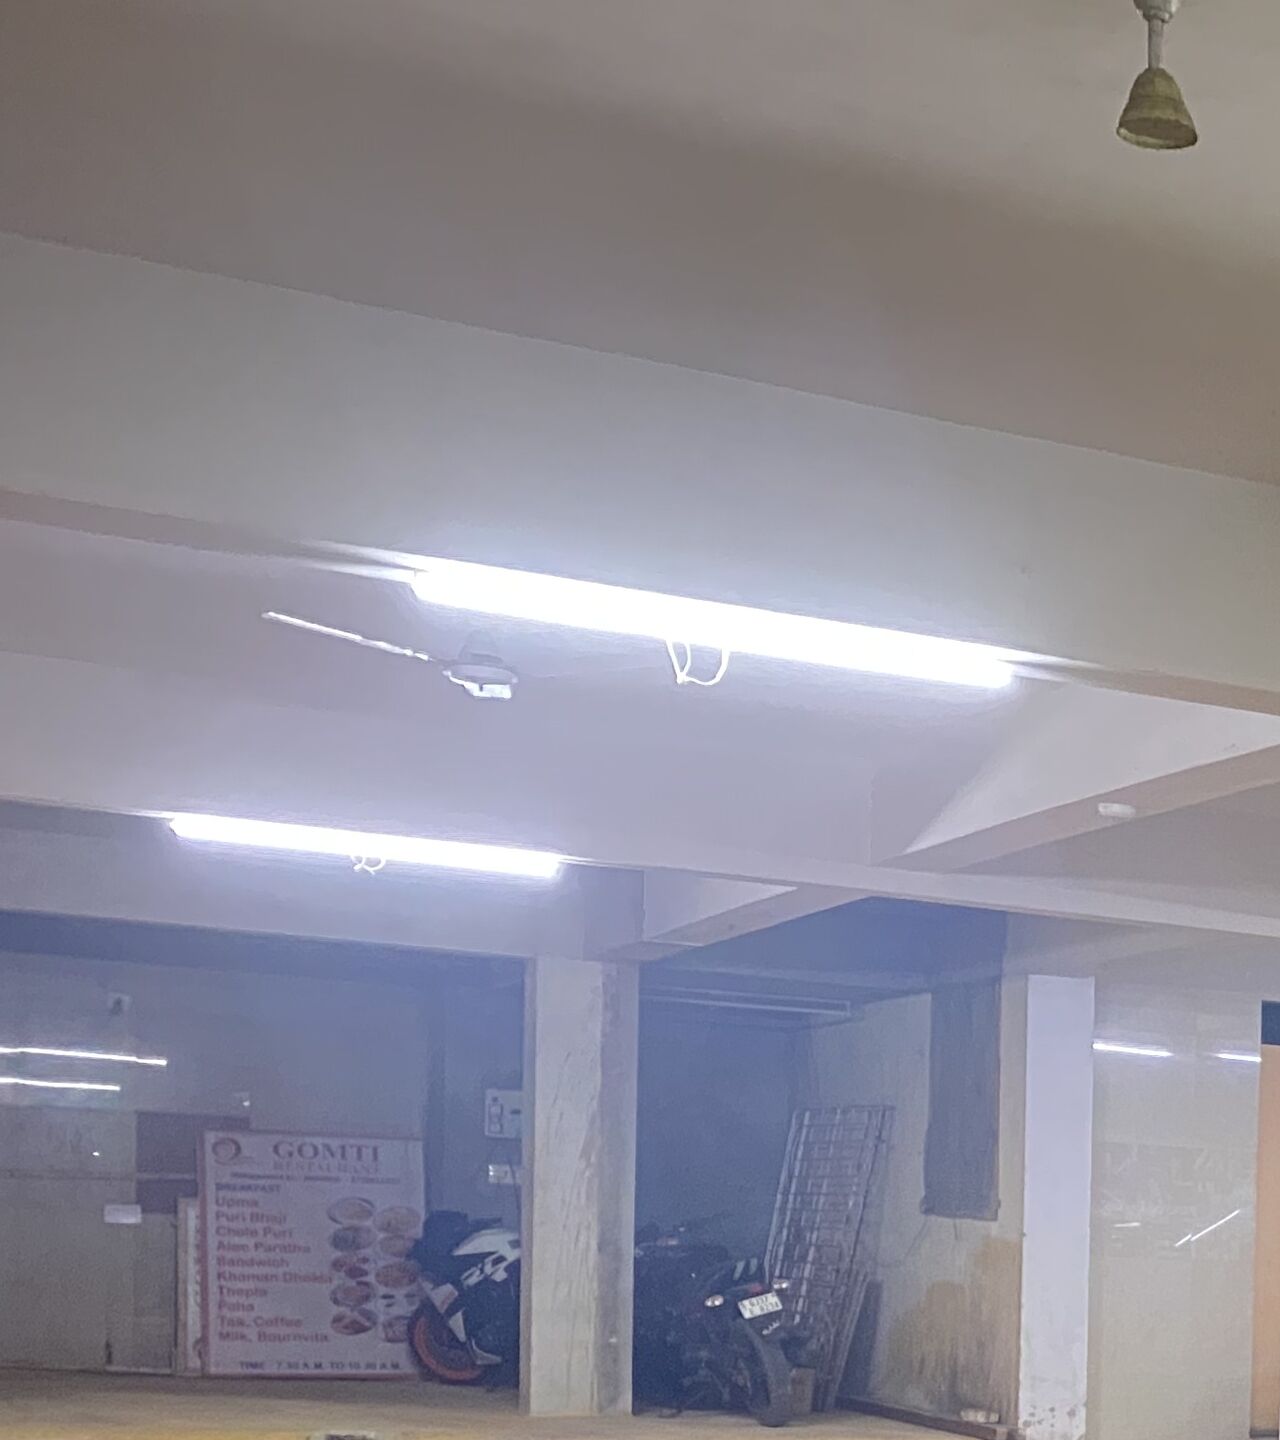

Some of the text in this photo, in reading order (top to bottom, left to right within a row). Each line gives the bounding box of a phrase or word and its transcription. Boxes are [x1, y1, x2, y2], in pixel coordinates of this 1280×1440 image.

[273, 1140, 379, 1162] GOMTI
[215, 1196, 259, 1208] Upma
[215, 1210, 246, 1223] Puri
[263, 1226, 293, 1239] Puri
[216, 1256, 289, 1268] Sandwich
[253, 1316, 303, 1328] Coffee
